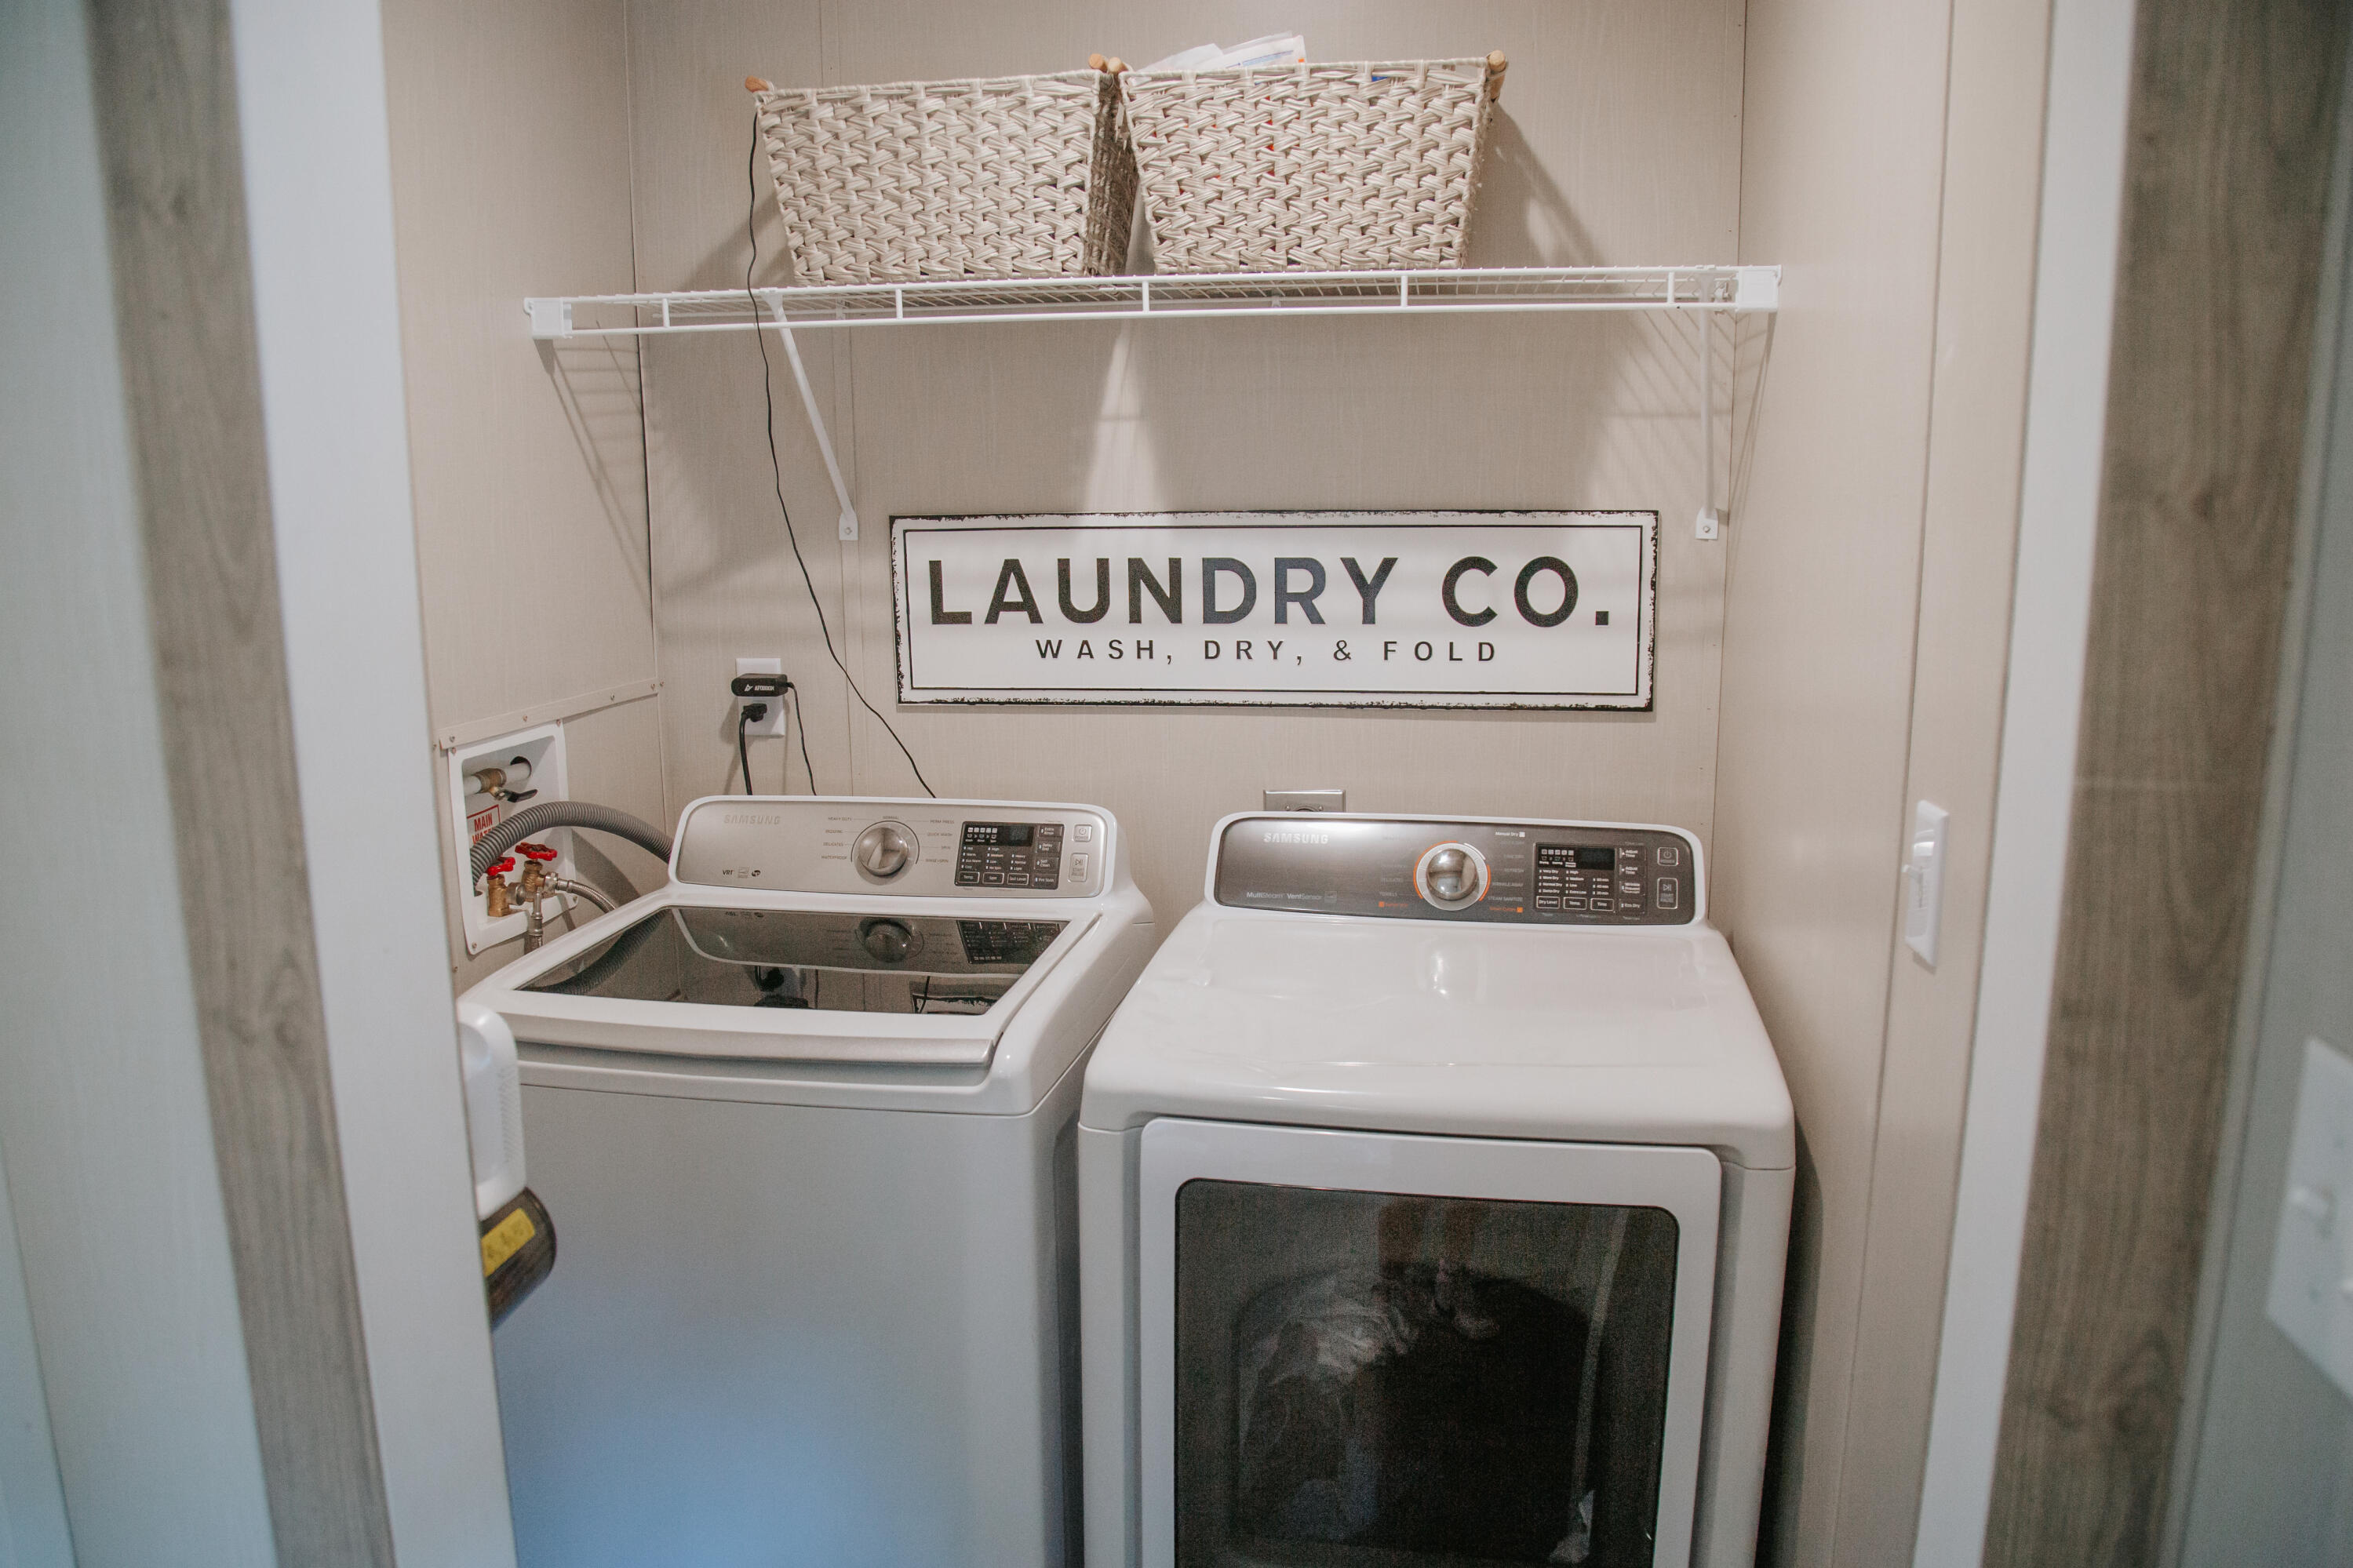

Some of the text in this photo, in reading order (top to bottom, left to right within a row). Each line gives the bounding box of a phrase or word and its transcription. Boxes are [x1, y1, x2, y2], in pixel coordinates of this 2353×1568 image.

[929, 556, 1609, 628] LAUNDRY CO.
[1035, 639, 1495, 666] WASH, DRY, & FOLD
[474, 812, 493, 832] MAIN
[723, 814, 780, 825] SAMSUNG
[1263, 832, 1329, 845] SAMSUNG
